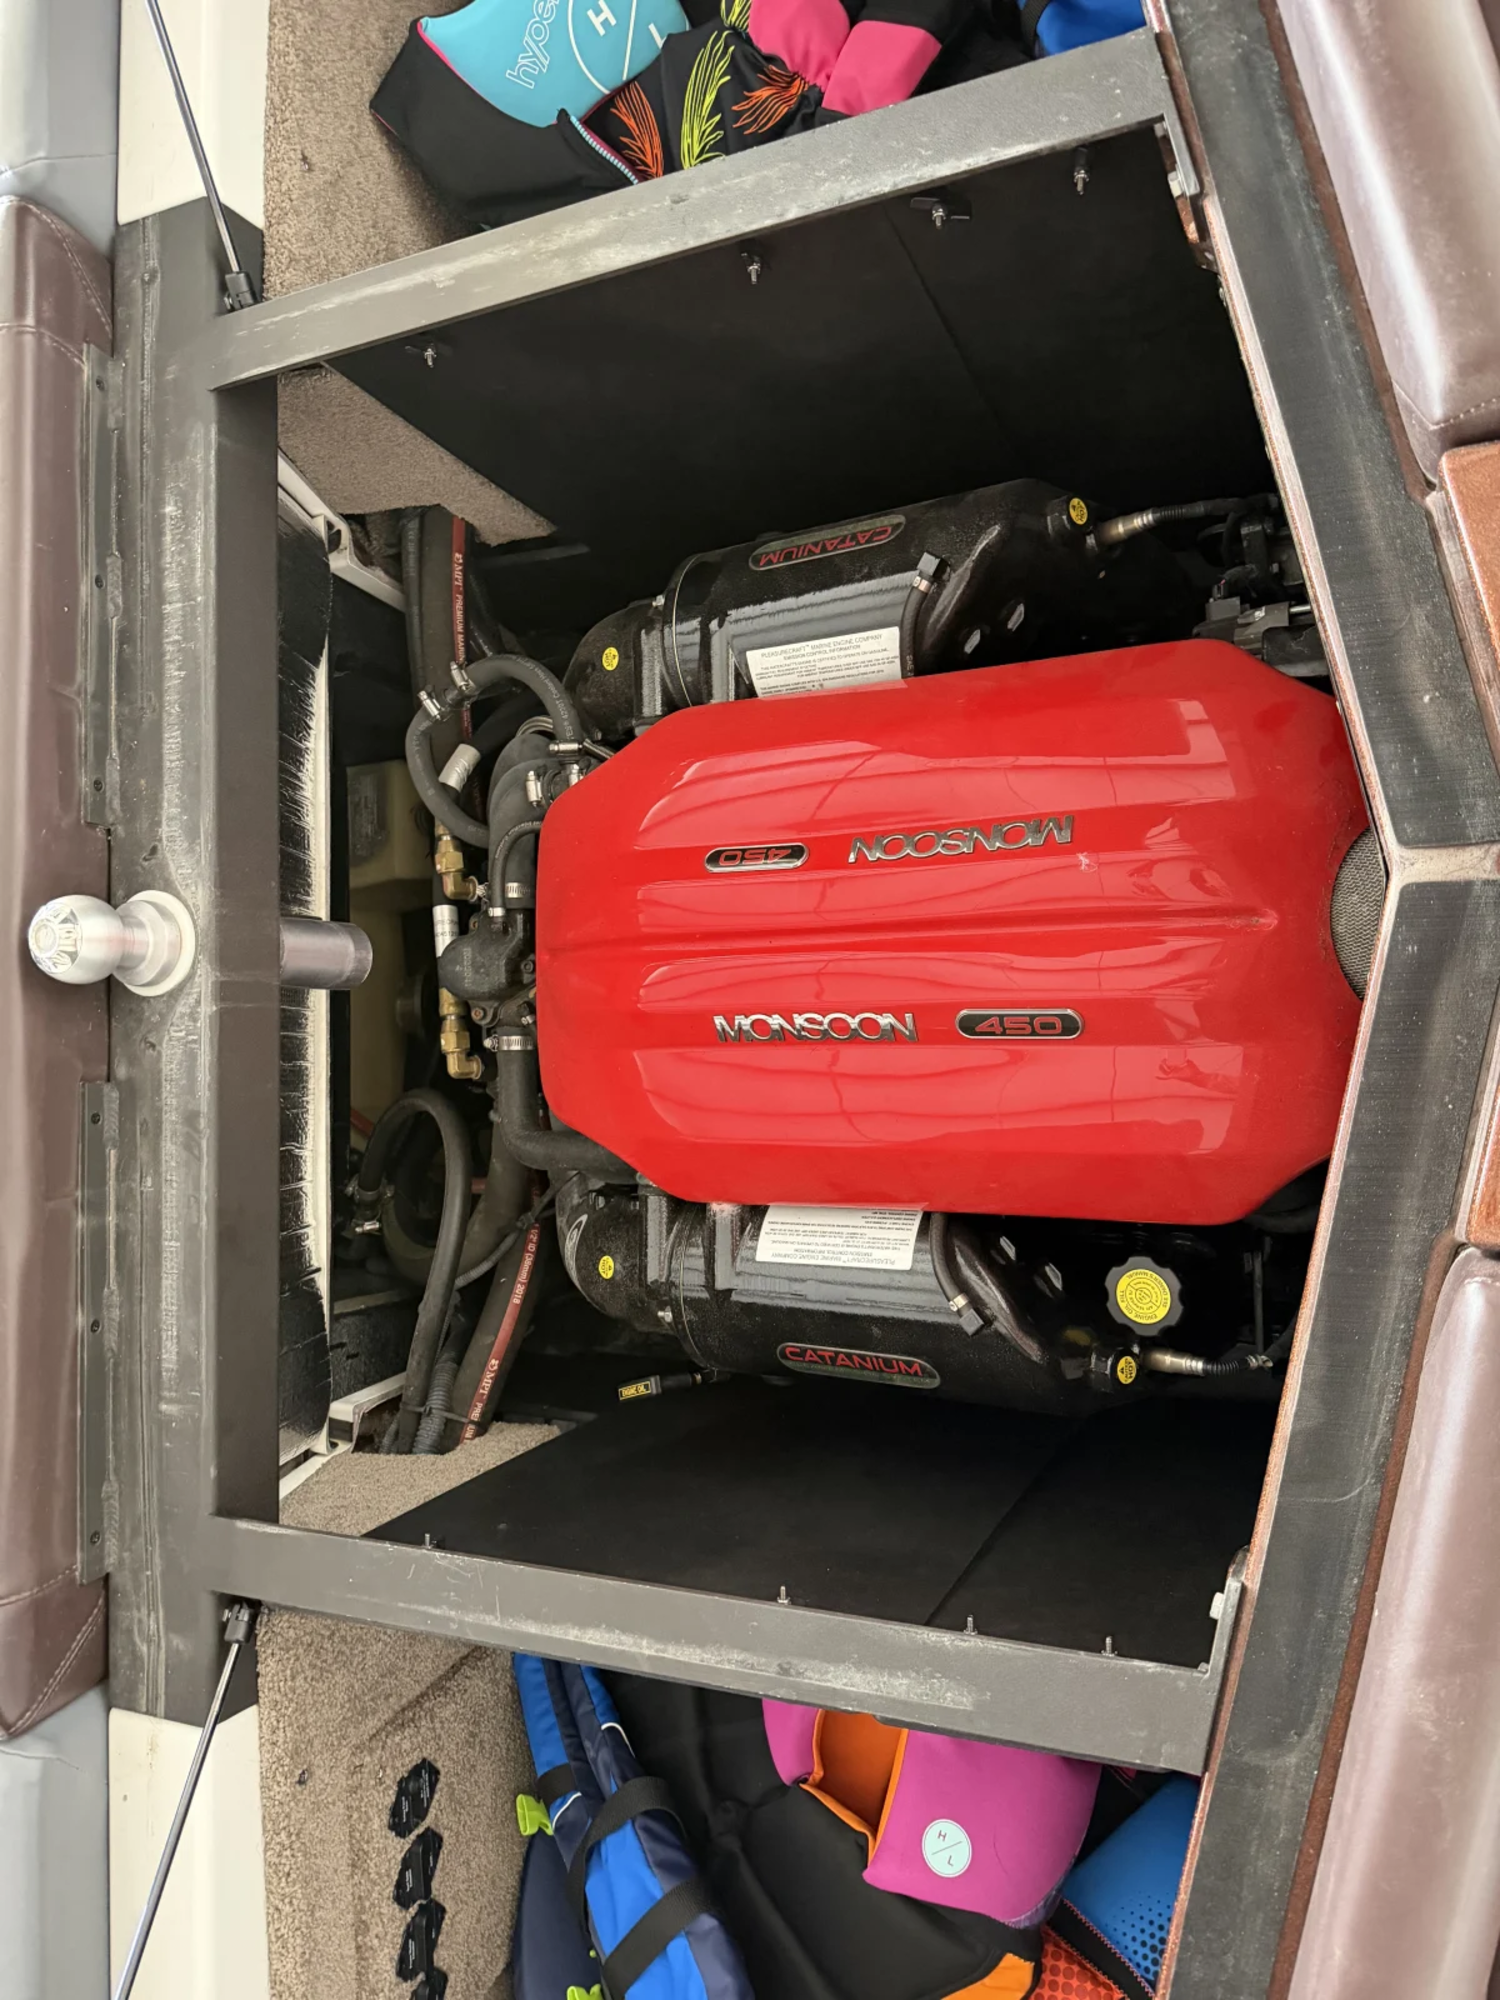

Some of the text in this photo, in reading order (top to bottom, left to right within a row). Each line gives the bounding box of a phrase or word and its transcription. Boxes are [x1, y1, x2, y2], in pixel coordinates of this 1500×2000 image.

[587, 0, 616, 36] H
[506, 0, 559, 89] hype
[760, 526, 892, 566] CATANIUM
[455, 594, 464, 632] PREMIUM
[810, 641, 831, 650] MARINE
[832, 638, 854, 646] ENGINE
[854, 633, 882, 643] COMPANY
[848, 816, 1074, 864] MONSOON
[719, 849, 792, 866] 450
[713, 1013, 919, 1042] MONSOON
[975, 1016, 1062, 1034] 450
[512, 1284, 526, 1304] 2018
[784, 1346, 923, 1377] CATANIUM
[938, 1830, 947, 1842] H
[947, 1855, 954, 1867] L
